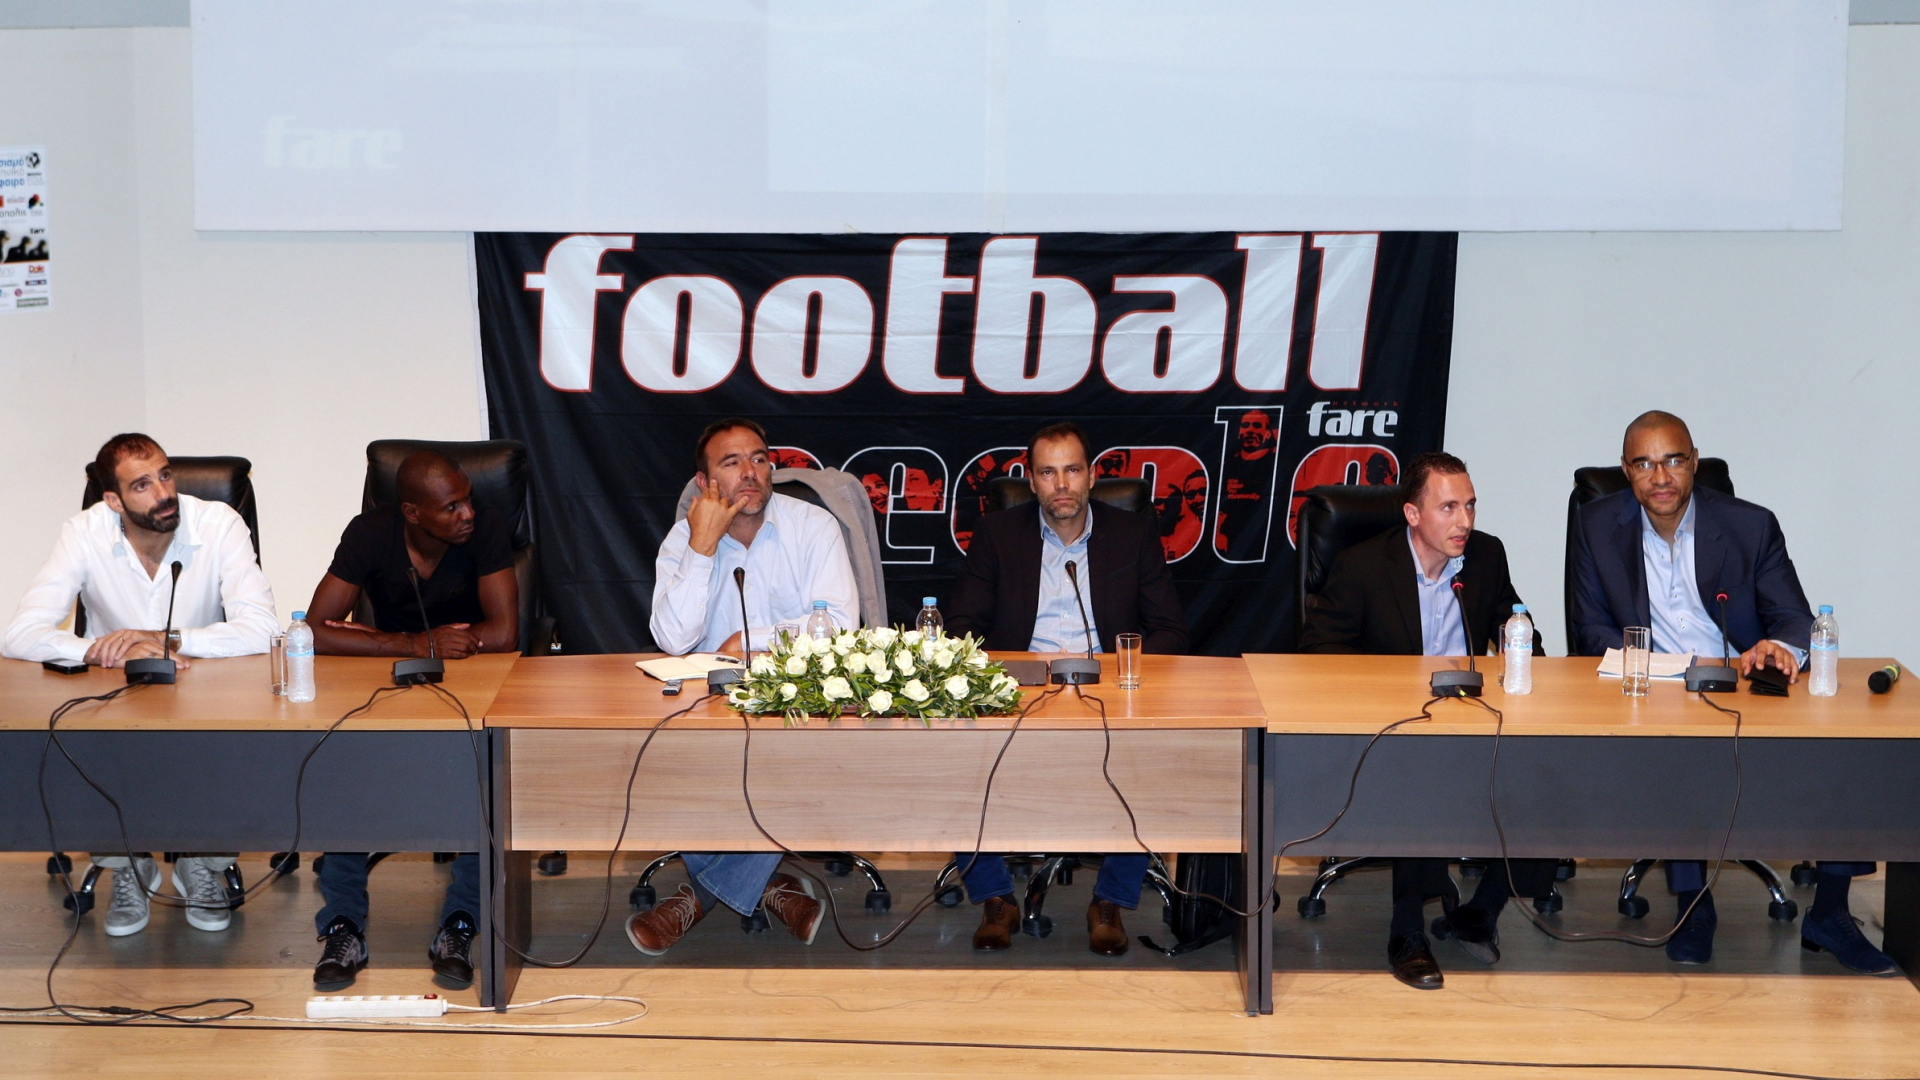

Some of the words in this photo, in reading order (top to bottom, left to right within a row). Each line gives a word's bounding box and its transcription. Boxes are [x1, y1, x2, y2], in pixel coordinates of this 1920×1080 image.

[263, 115, 403, 169] fare
[523, 232, 1382, 394] football
[1306, 401, 1399, 437] fare
